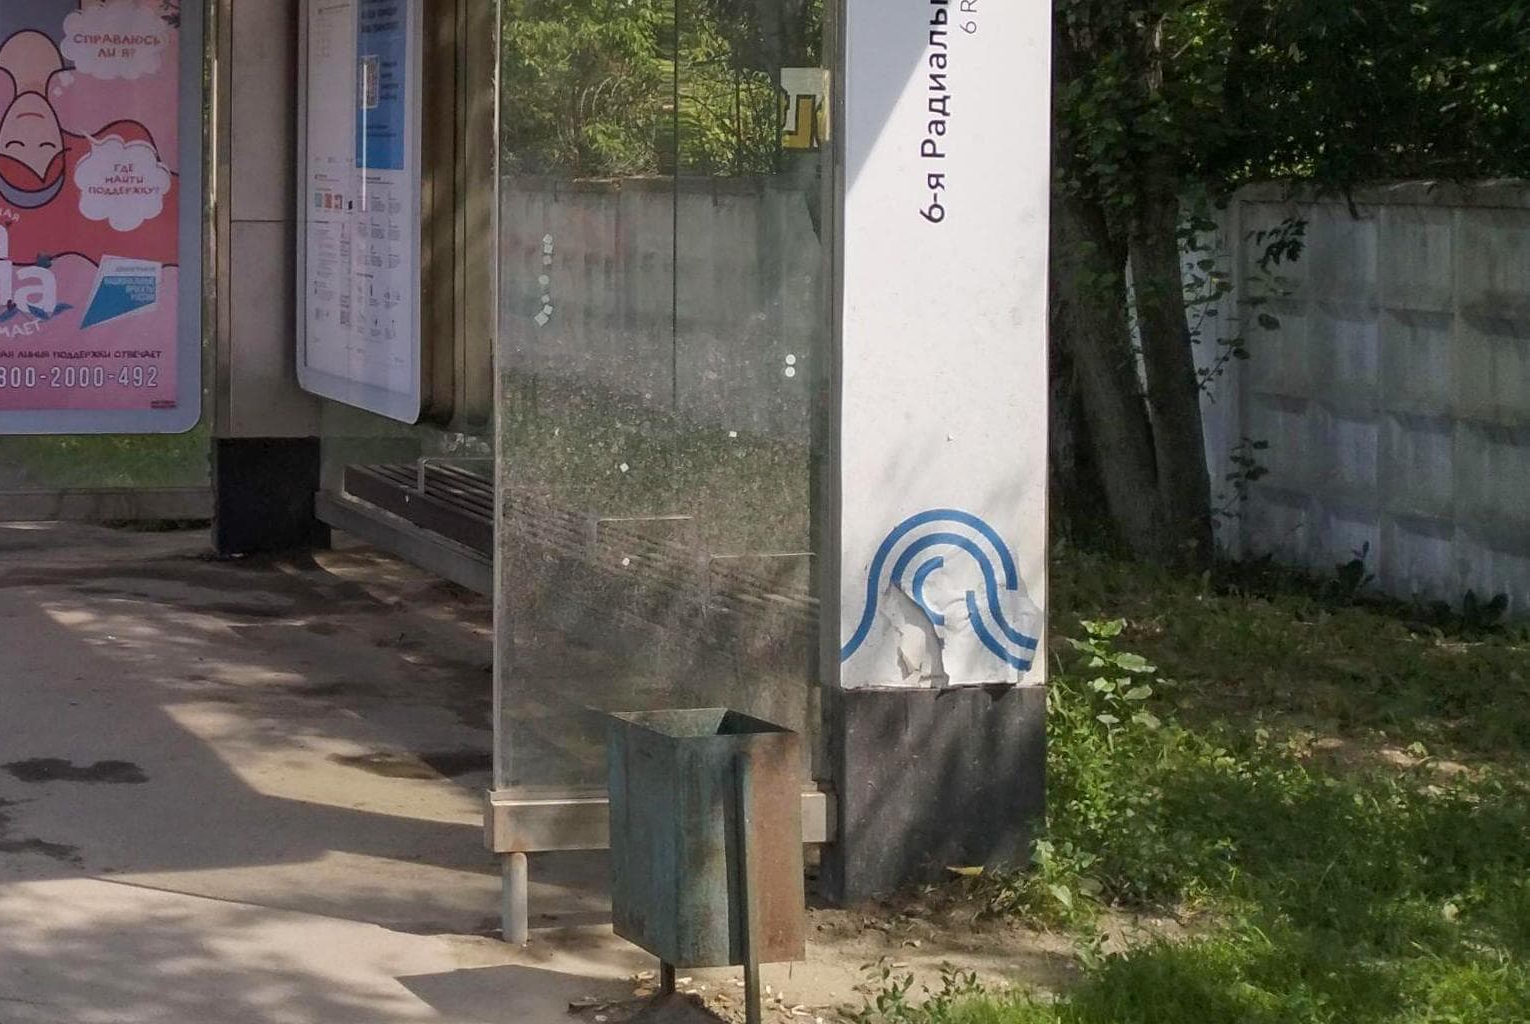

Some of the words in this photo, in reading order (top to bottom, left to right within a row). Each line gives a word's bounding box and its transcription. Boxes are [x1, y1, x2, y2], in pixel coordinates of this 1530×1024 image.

[959, 20, 978, 35] 6
[73, 33, 160, 46] СПРАВЛЮСЬ
[98, 48, 116, 58] ЛИ
[121, 48, 137, 58] Я?
[113, 163, 134, 173] ГДЕ
[919, 172, 946, 224] 6-я
